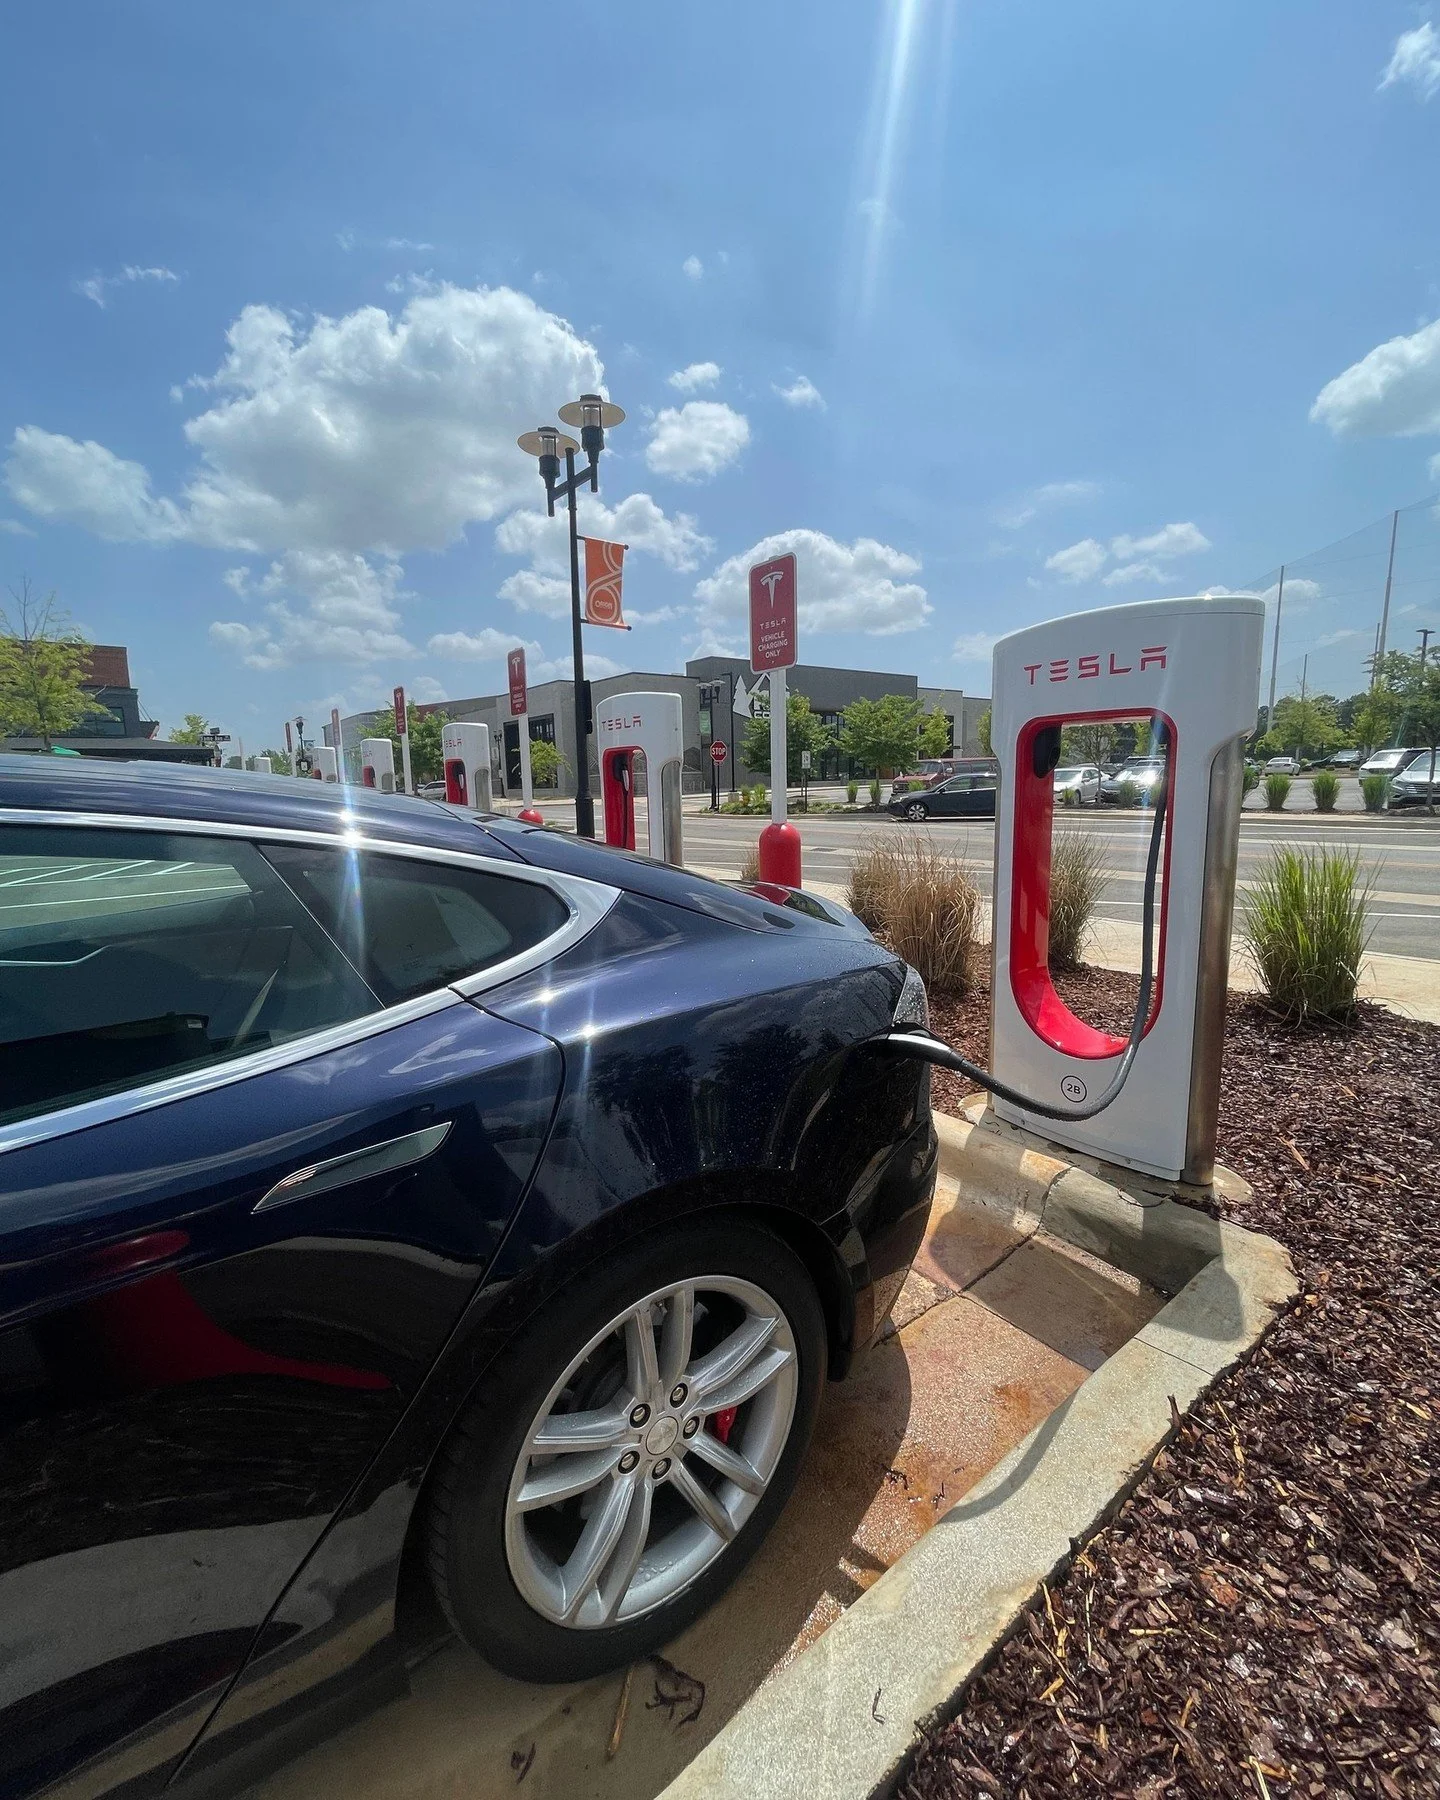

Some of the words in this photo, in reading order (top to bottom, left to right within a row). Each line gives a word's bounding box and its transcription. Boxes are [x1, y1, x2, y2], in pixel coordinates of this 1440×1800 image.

[760, 617, 787, 630] TESLA
[760, 631, 785, 643] VEHICLE
[758, 638, 788, 652] CHARGING
[765, 649, 781, 659] ONLY
[1023, 646, 1168, 686] TESLA
[601, 715, 642, 731] TESLA
[711, 747, 726, 756] STOP
[1066, 1083, 1081, 1095] 2B
